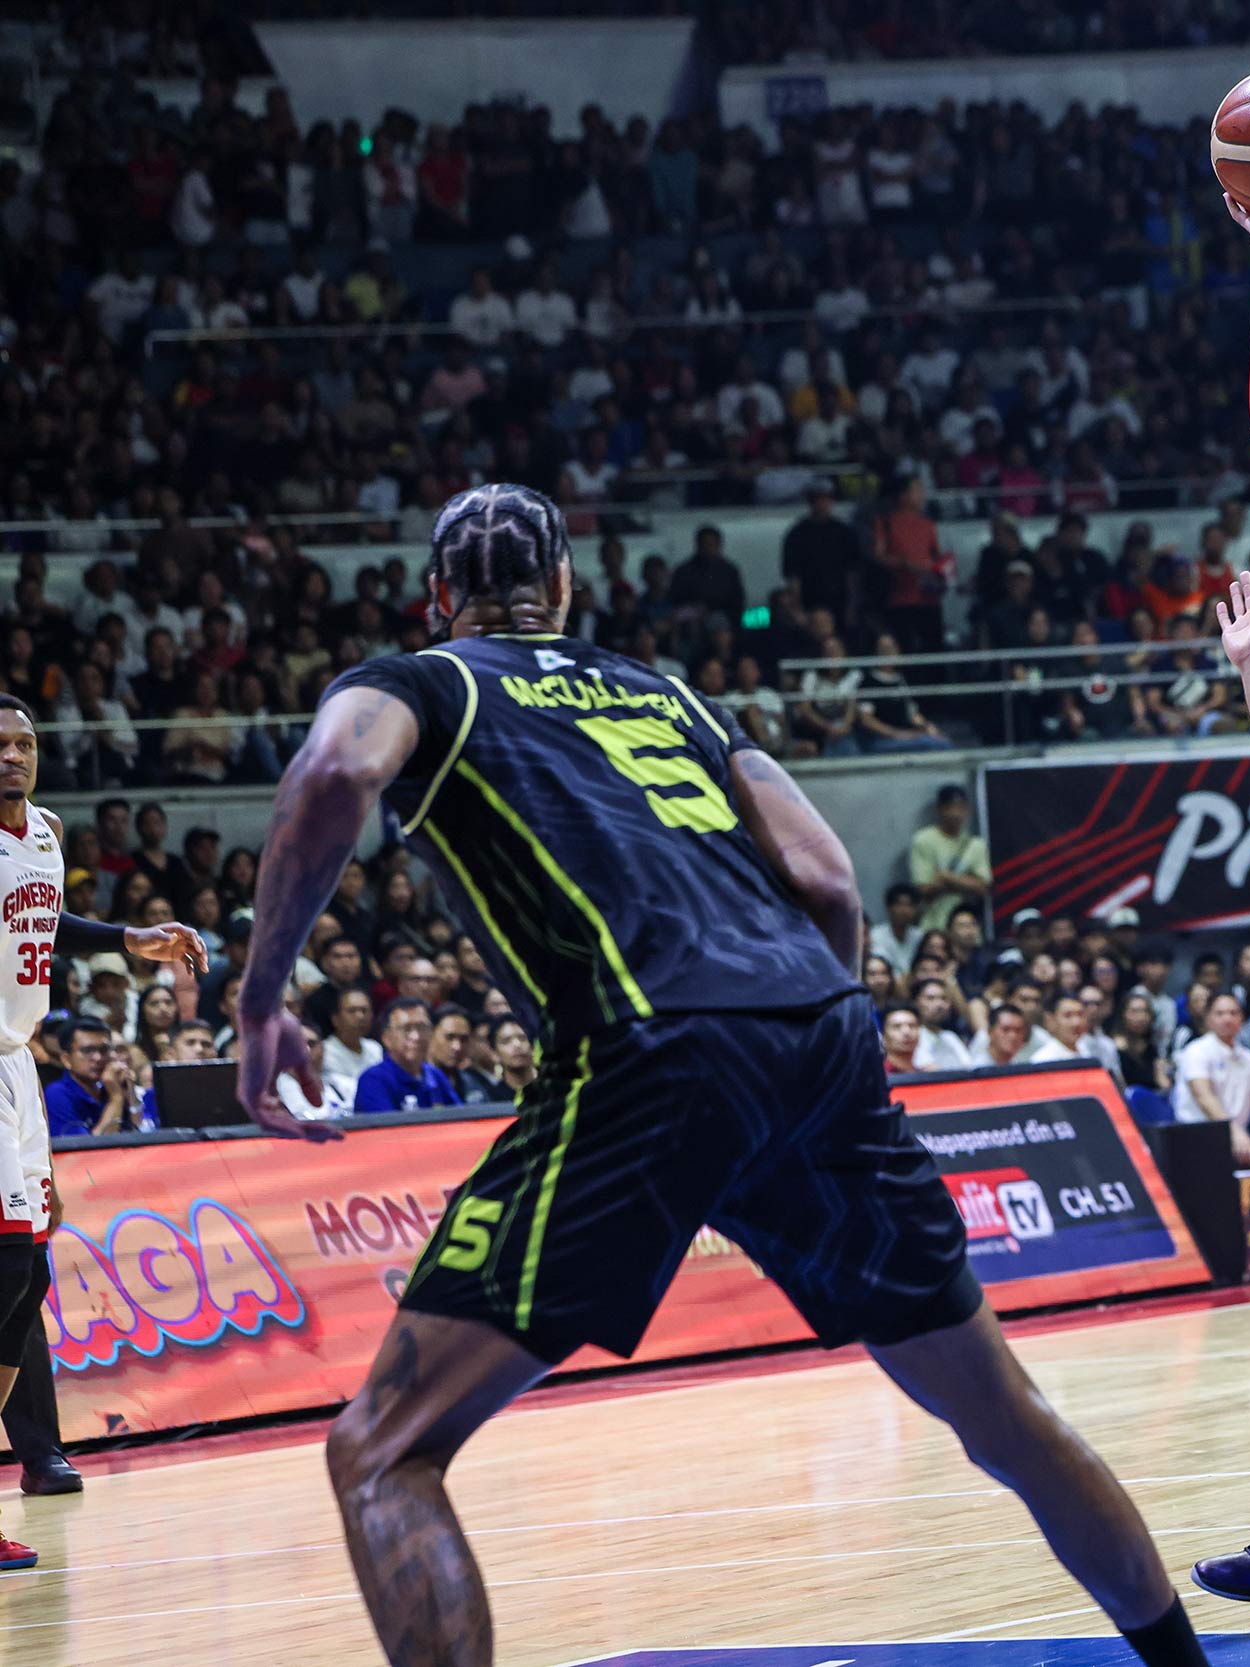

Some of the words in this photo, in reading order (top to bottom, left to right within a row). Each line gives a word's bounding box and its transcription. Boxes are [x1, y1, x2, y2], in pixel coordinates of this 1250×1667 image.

[573, 715, 740, 834] 5
[9, 917, 30, 934] SAN
[16, 942, 52, 986] 32
[305, 1187, 460, 1257] MON-
[439, 1195, 504, 1273] 5
[953, 1180, 1006, 1230] ulit
[1006, 1190, 1039, 1231] tv
[46, 1200, 298, 1356] AGA
